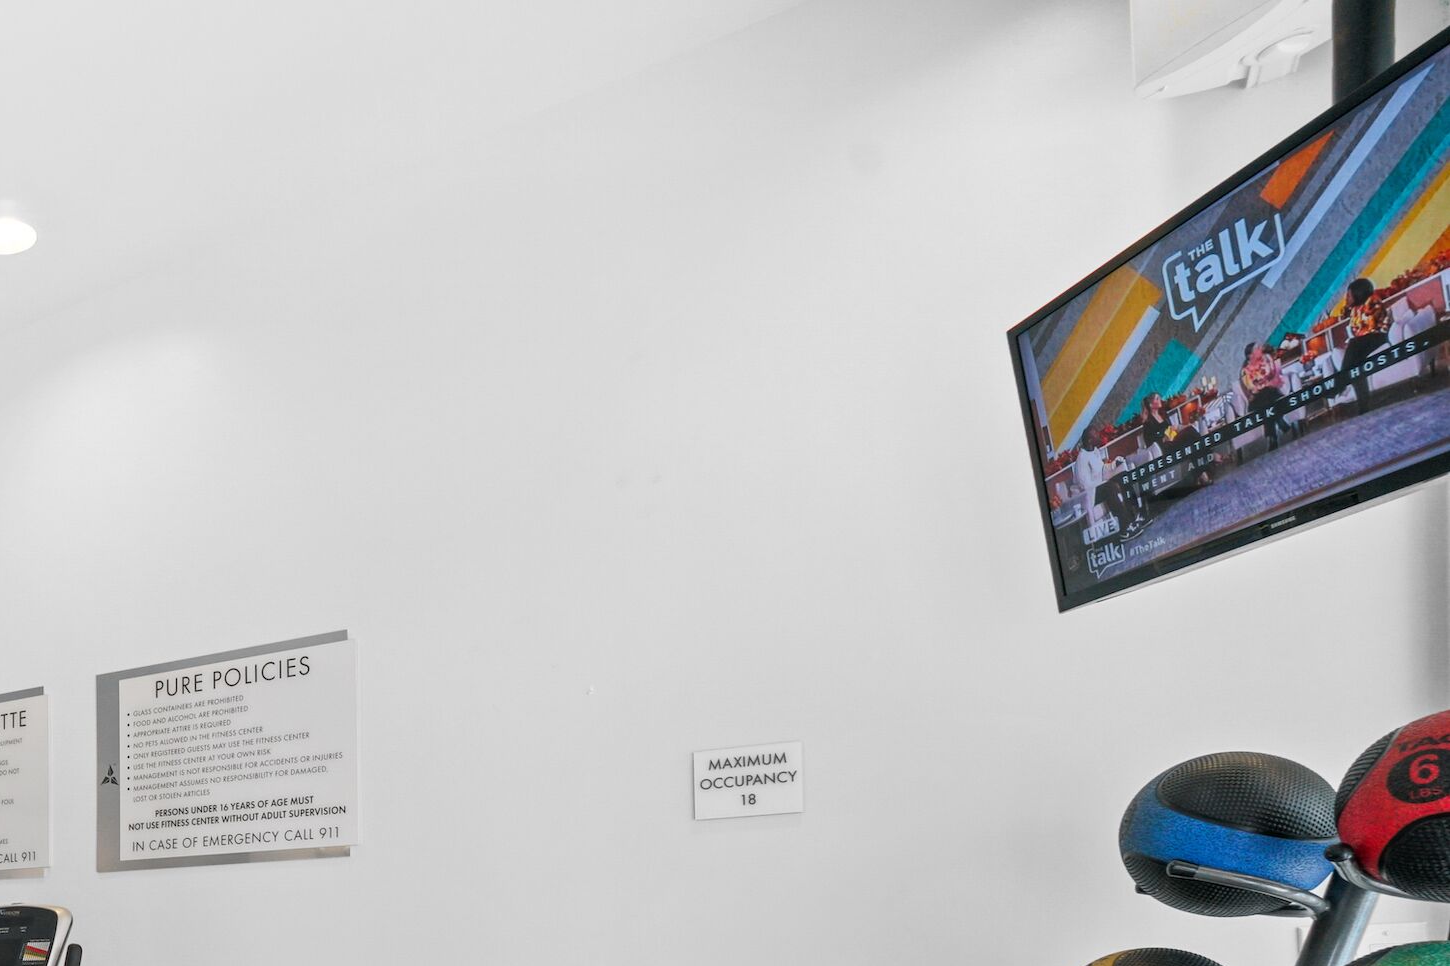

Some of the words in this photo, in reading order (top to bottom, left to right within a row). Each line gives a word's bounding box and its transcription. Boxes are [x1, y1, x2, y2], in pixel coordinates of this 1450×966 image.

[1174, 218, 1274, 302] talk
[1188, 239, 1214, 261] THE
[1122, 432, 1222, 485] REPRESENTED
[1234, 406, 1276, 432] TALK
[1289, 378, 1335, 407] SHOW
[1141, 470, 1176, 491] WENT
[1187, 453, 1214, 472] AND
[1086, 520, 1117, 542] LIVE
[1090, 543, 1122, 568] talk
[1130, 536, 1166, 556] #TheTalk
[155, 673, 203, 699] PURE
[213, 655, 311, 690] POLICIES
[133, 708, 152, 717] GLASS
[153, 702, 193, 714] CONTAINERS
[194, 700, 205, 708] ARE
[207, 694, 244, 706] PROHIBITED
[133, 719, 151, 728] FOOD
[152, 717, 166, 725] AND
[168, 712, 197, 723] ALCOHOL
[199, 710, 210, 719] ARE
[212, 705, 249, 717] PROHIBITED
[133, 727, 170, 739] APPROPRIATE
[172, 724, 191, 733] ATTIRE
[200, 719, 231, 729] REQUIRED
[145, 740, 159, 748] PETS
[160, 736, 188, 746] ALLOWED
[190, 734, 198, 742] IN
[199, 733, 210, 741] THE
[212, 729, 236, 739] FITNESS
[238, 725, 263, 736] CENTER
[133, 752, 149, 760] ONLY
[151, 747, 186, 758] REGISTERED
[187, 744, 211, 753] GUESTS
[212, 742, 226, 750] MAY
[228, 740, 240, 748] USE
[242, 738, 254, 746] THE
[256, 735, 282, 745] FITNESS
[284, 731, 310, 741] CENTER
[133, 770, 178, 781] MANAGEMENT
[187, 767, 200, 775] NOT
[202, 762, 243, 774] RESPONSIBLE
[245, 761, 258, 769] FOR
[260, 756, 298, 767] ACCIDENTS
[300, 754, 310, 763] OR
[312, 751, 343, 761] INJURIES
[134, 763, 145, 771] USE
[158, 758, 182, 768] FITNESS
[183, 755, 206, 765] CENTER
[208, 754, 215, 762] AT
[217, 752, 235, 761] YOUR
[237, 749, 255, 758] OWN
[257, 747, 271, 756] RISK
[708, 752, 787, 771] MAXIMUM
[1409, 754, 1440, 785] 6
[133, 781, 178, 792] MANAGEMENT
[179, 777, 209, 787] ASSUMES
[210, 776, 221, 784] NO
[223, 770, 273, 782] RESPONSIBILITY
[275, 769, 289, 777] FOR
[700, 770, 797, 790] OCCUPANCY
[133, 795, 147, 803] LOST
[159, 791, 182, 800] STOLEN
[183, 788, 210, 798] ARTICLES
[155, 807, 189, 818] PERSONS
[191, 804, 217, 814] UNDER
[220, 803, 229, 812] 16
[231, 801, 256, 811] YEARS
[257, 799, 269, 809] OF
[271, 798, 288, 807] AGE
[290, 795, 314, 806] MUST
[741, 793, 757, 806] 18
[129, 822, 145, 831] NOT
[146, 821, 160, 830] USE
[161, 818, 190, 829] FITNESS
[191, 816, 220, 826] CENTER
[222, 812, 259, 824] WITHOUT
[261, 810, 287, 820] ADULT
[289, 805, 346, 818] SUPERVISION
[132, 841, 145, 852] IN
[149, 838, 178, 851] CASE
[182, 836, 199, 849] OF
[203, 830, 279, 847] EMERGENCY
[284, 828, 314, 842] CALL
[319, 826, 340, 839] 911
[21, 851, 37, 862] 911
